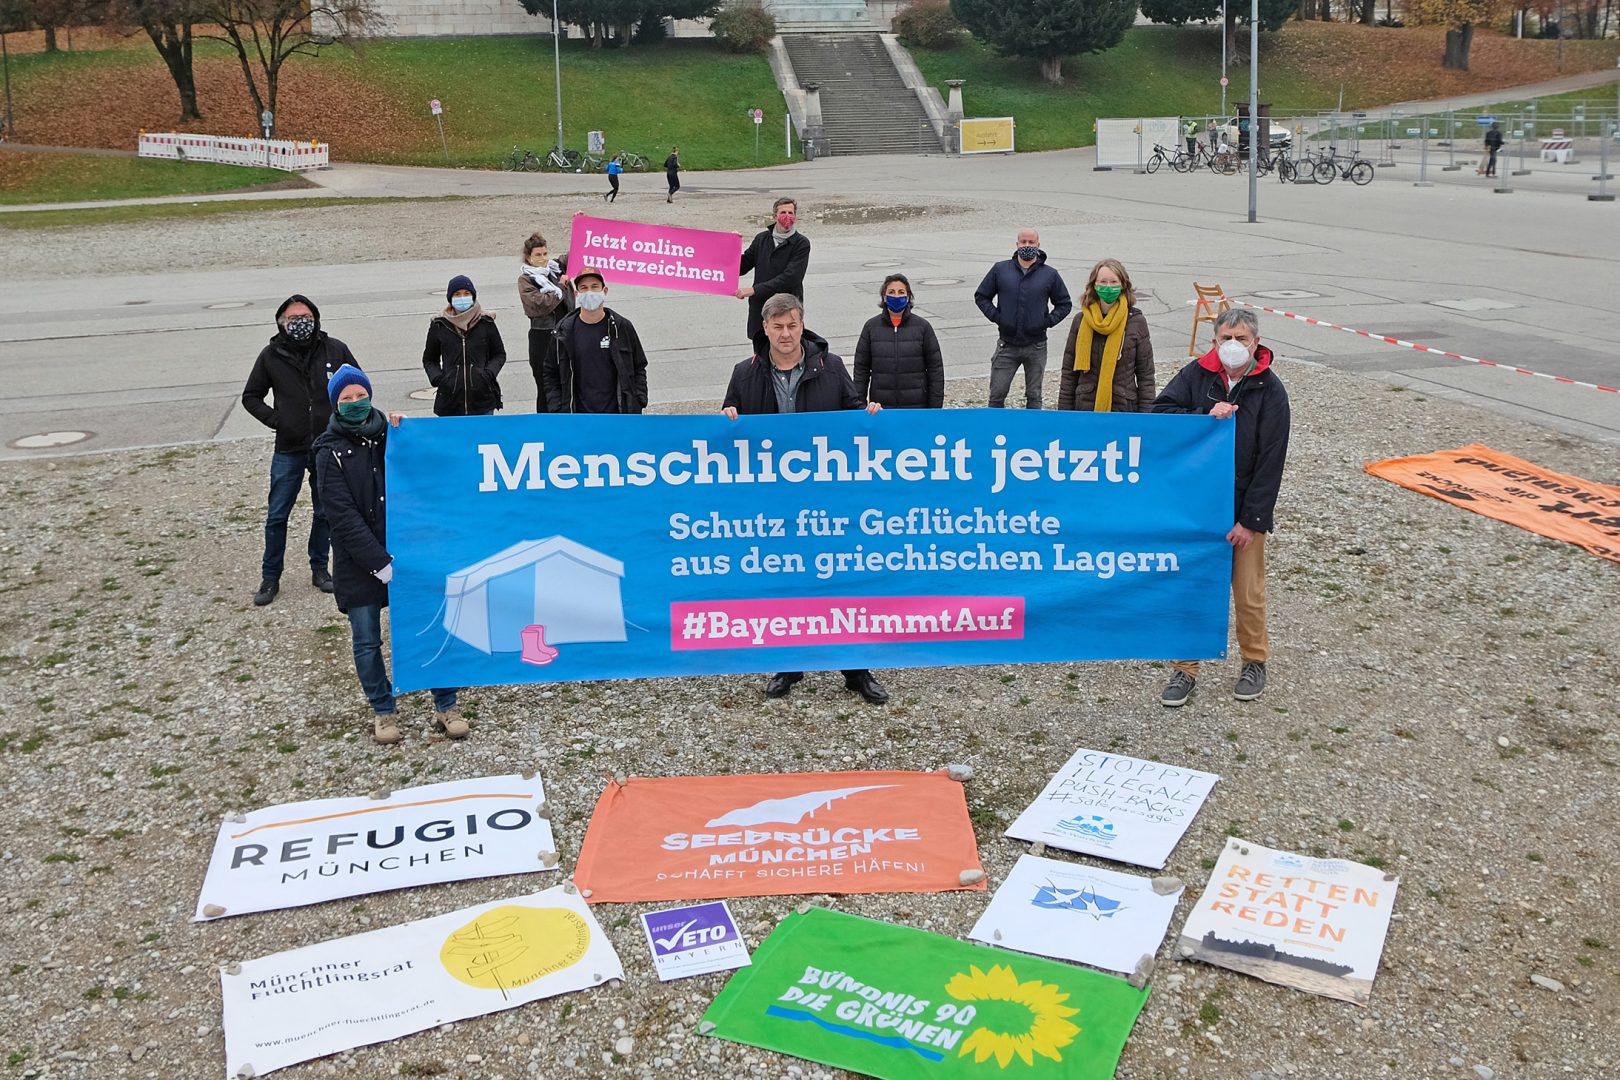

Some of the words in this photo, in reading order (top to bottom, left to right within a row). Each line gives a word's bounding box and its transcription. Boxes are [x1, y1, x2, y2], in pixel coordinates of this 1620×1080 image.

[584, 230, 627, 251] Jetzt
[632, 239, 695, 258] online
[583, 254, 725, 282] unterzeichnen
[478, 434, 972, 492] Menschlichkeit
[991, 434, 1141, 493] jetzt!
[669, 512, 785, 540] Schutz
[796, 510, 849, 536] für
[859, 507, 1060, 535] Geflüchtete
[671, 555, 730, 576] aus
[740, 546, 805, 574] den
[815, 543, 1042, 579] griechischen
[1053, 544, 1179, 579] Lagern
[682, 607, 1015, 644] #BayernNimmtAuf
[1072, 768, 1199, 804] ILLEGALE
[1079, 753, 1203, 786] STOPPT
[1059, 779, 1186, 817] PUSH-BACKS
[230, 808, 532, 869] REFUGIO
[660, 827, 922, 850] SEEBRÜCKE
[709, 843, 872, 866] MÜNCHEN
[281, 843, 484, 884] MÜNCHEN
[756, 863, 843, 878] SICHERE
[854, 857, 926, 874] HÄFEN!
[1218, 882, 1338, 918] STATT
[1227, 864, 1378, 907] RETTEN
[1211, 901, 1346, 942] REDEN
[250, 960, 361, 989] Münchner
[511, 959, 569, 987] Münchner
[798, 965, 931, 1016] BÜNDNIS
[934, 1003, 976, 1026] 90
[778, 986, 832, 1012] DIE
[836, 1000, 963, 1050] GRÜNEN
